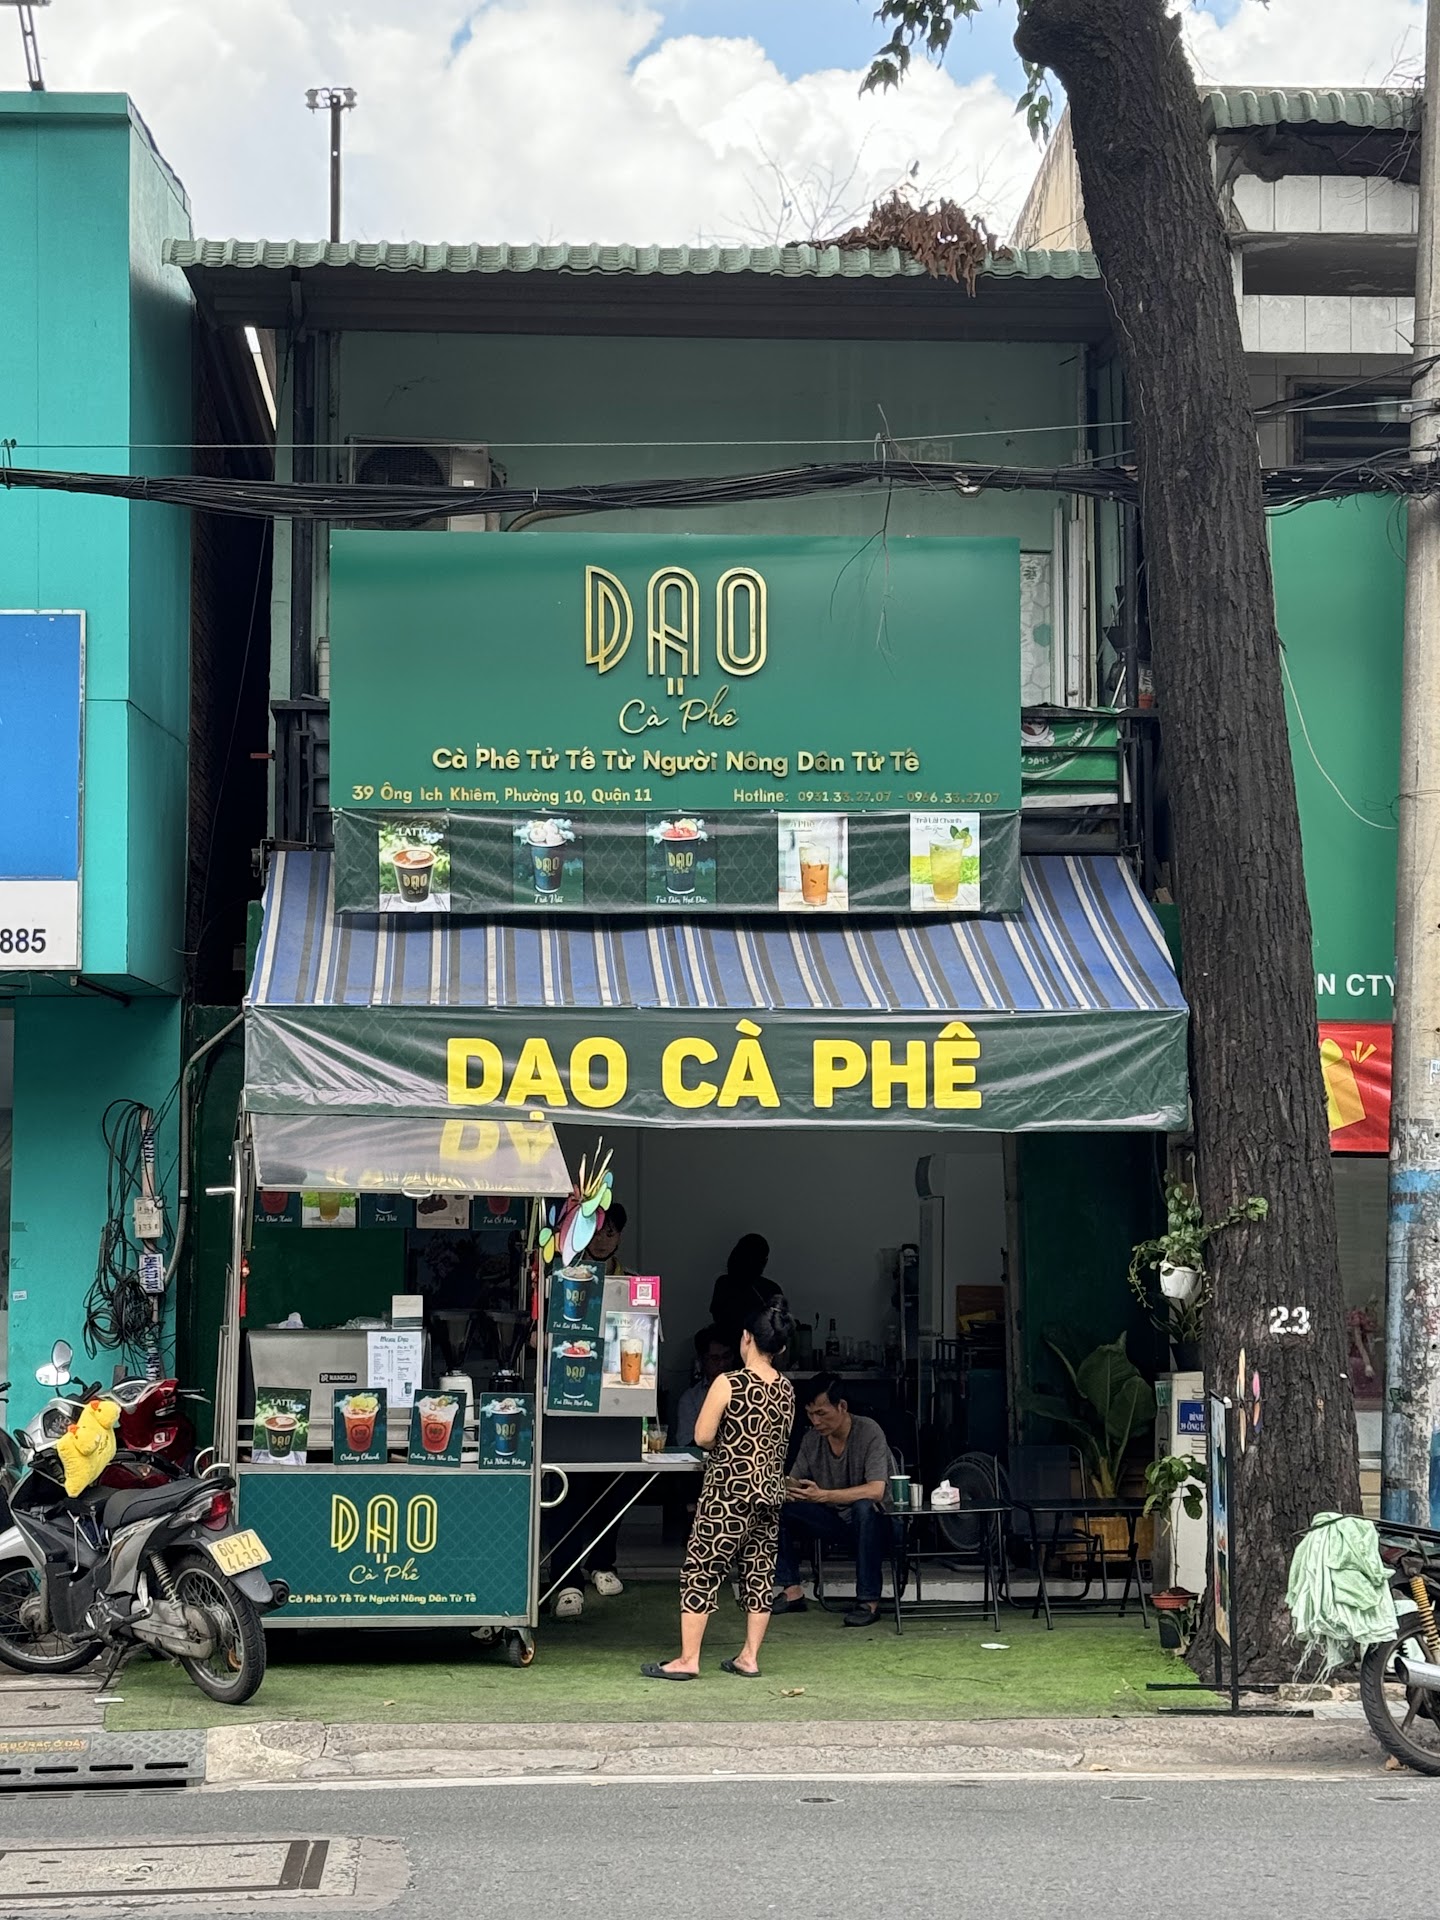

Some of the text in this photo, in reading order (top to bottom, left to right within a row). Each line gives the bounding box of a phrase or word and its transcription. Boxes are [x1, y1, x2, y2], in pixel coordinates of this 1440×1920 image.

[619, 684, 740, 734] Cà Phê
[432, 742, 920, 778] Cà Phê Tử Tế Từ Người Nông Dân Tử Tế
[351, 785, 375, 801] 39
[380, 781, 413, 804] Ông
[449, 786, 500, 804] Khiêm,
[504, 787, 560, 806] Phường
[564, 789, 587, 806] 10,
[591, 788, 631, 805] Quận
[634, 788, 653, 802] 11
[733, 788, 789, 803] Hotline:
[0, 928, 47, 954] 885
[661, 1018, 781, 1109] CÀ
[813, 1021, 983, 1109] PHÊ
[1269, 1306, 1311, 1335] 23
[227, 1548, 263, 1570] 4439
[349, 1557, 420, 1585] Cà Phê
[288, 1594, 303, 1603] Cà
[304, 1594, 323, 1603] Phê
